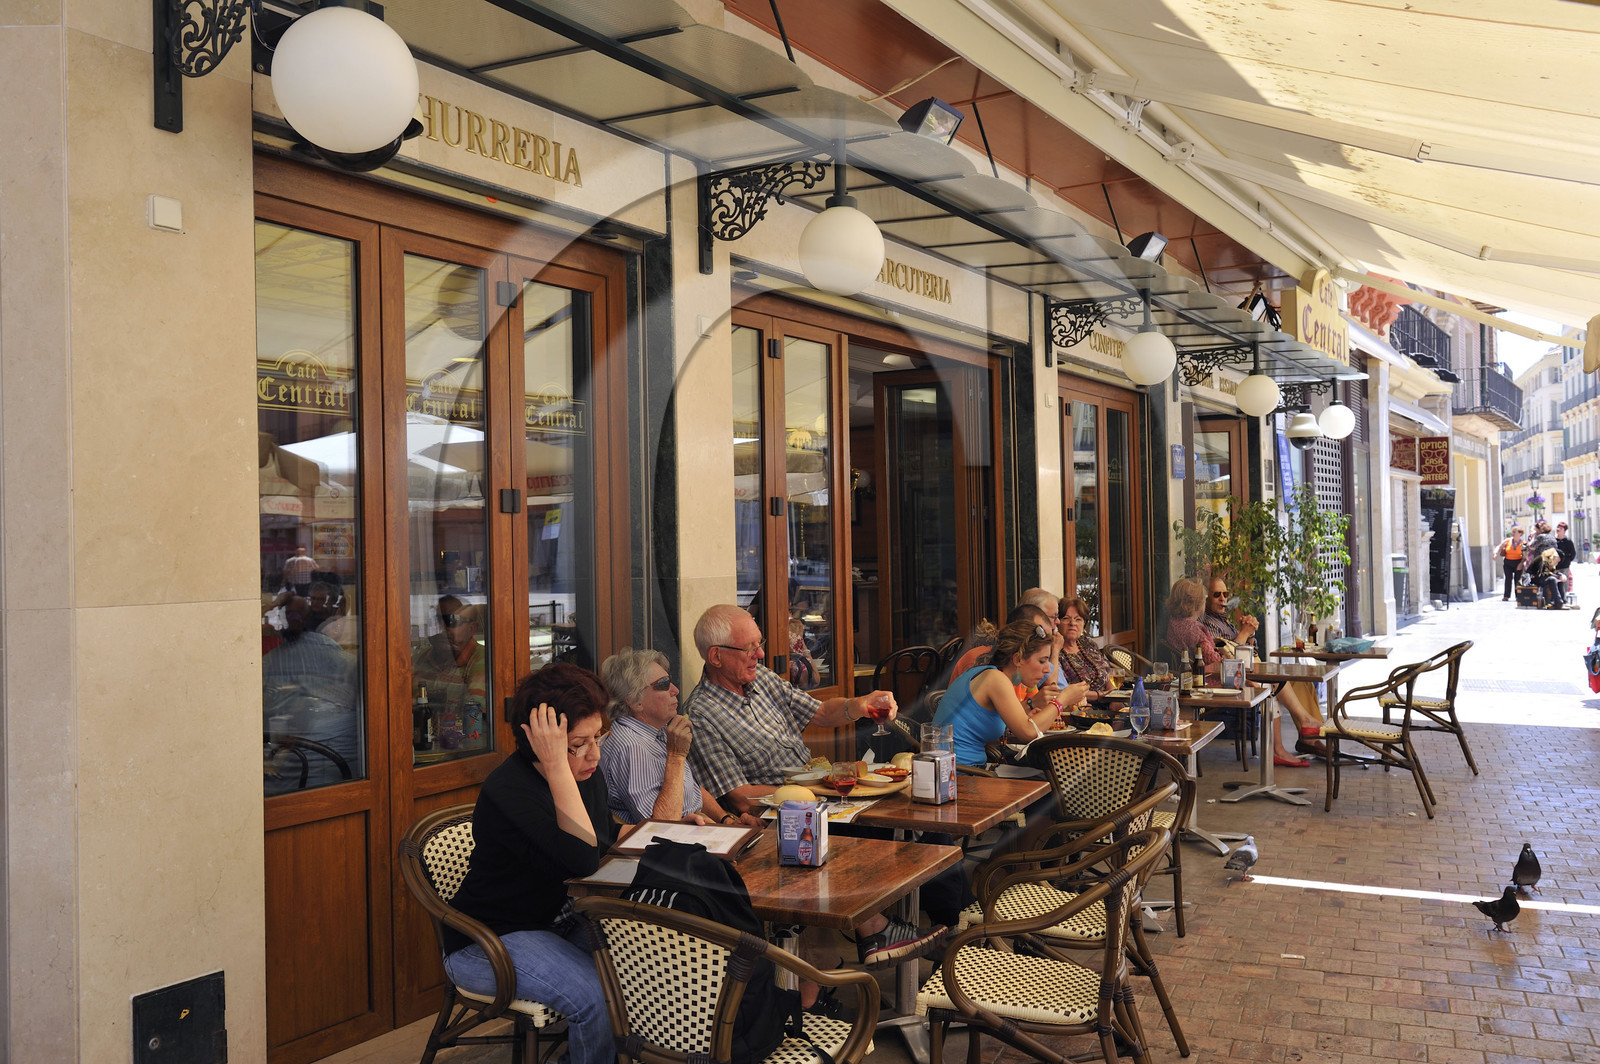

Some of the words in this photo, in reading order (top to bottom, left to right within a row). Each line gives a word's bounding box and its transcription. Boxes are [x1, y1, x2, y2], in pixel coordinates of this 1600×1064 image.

[1302, 303, 1347, 361] Central
[257, 376, 345, 407] Central
[406, 392, 476, 419] Central
[525, 405, 583, 428] Central
[1420, 440, 1448, 449] OPTICA
